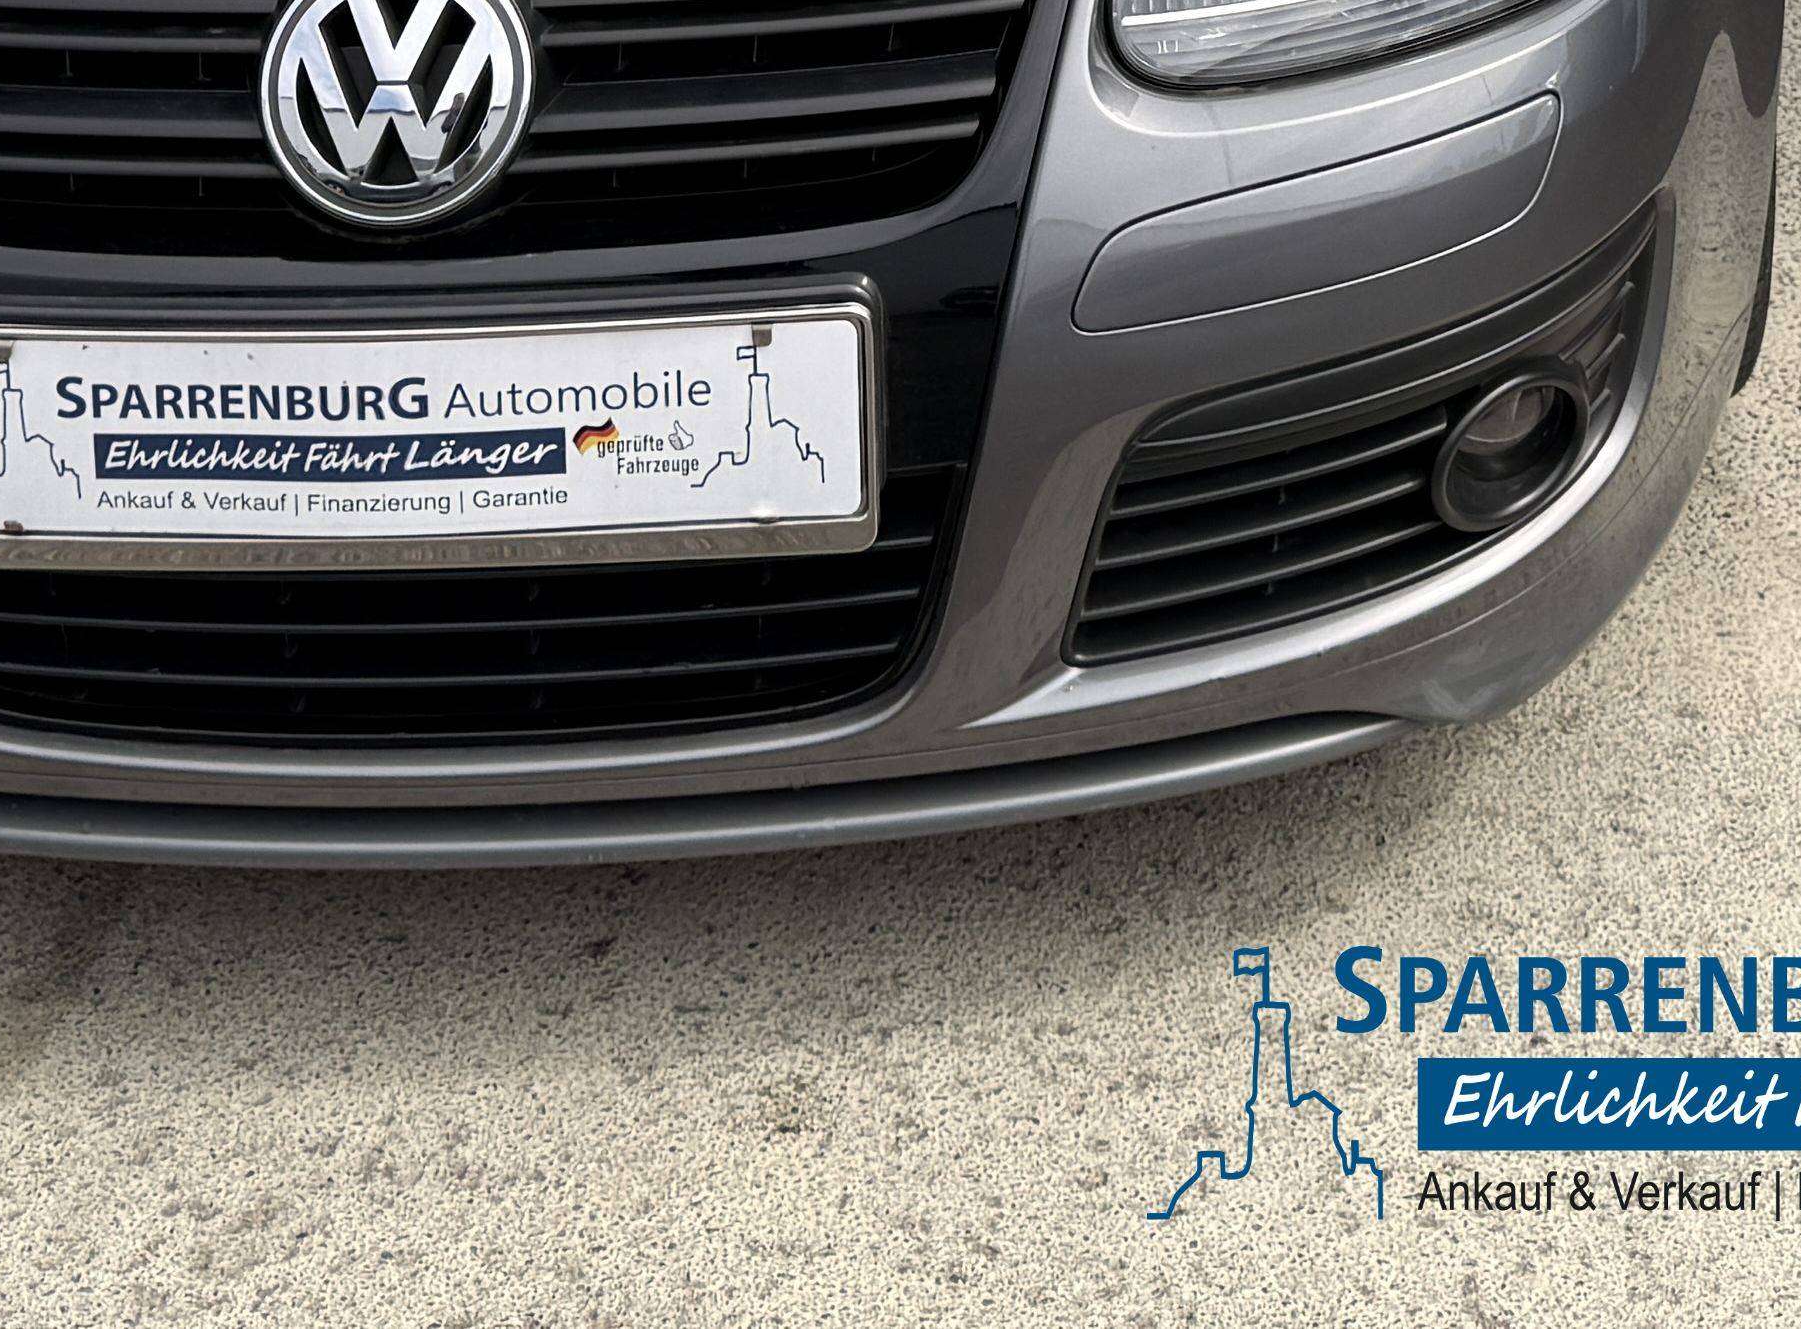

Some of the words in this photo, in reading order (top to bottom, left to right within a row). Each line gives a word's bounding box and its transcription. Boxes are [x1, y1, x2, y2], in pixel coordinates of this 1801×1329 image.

[56, 376, 429, 421] SPARRENBURG
[444, 369, 711, 419] Automobile
[104, 440, 301, 473] Ehrlichkeit
[304, 442, 401, 475] Fährt
[403, 439, 558, 475] Länger
[597, 434, 663, 458] geprüfte
[617, 456, 700, 476] Fahrzeuge
[96, 490, 174, 511] Ankauf
[181, 492, 197, 511] &
[203, 492, 287, 512] Verkauf
[307, 493, 451, 515] Finanzierung
[473, 486, 568, 508] Garantie
